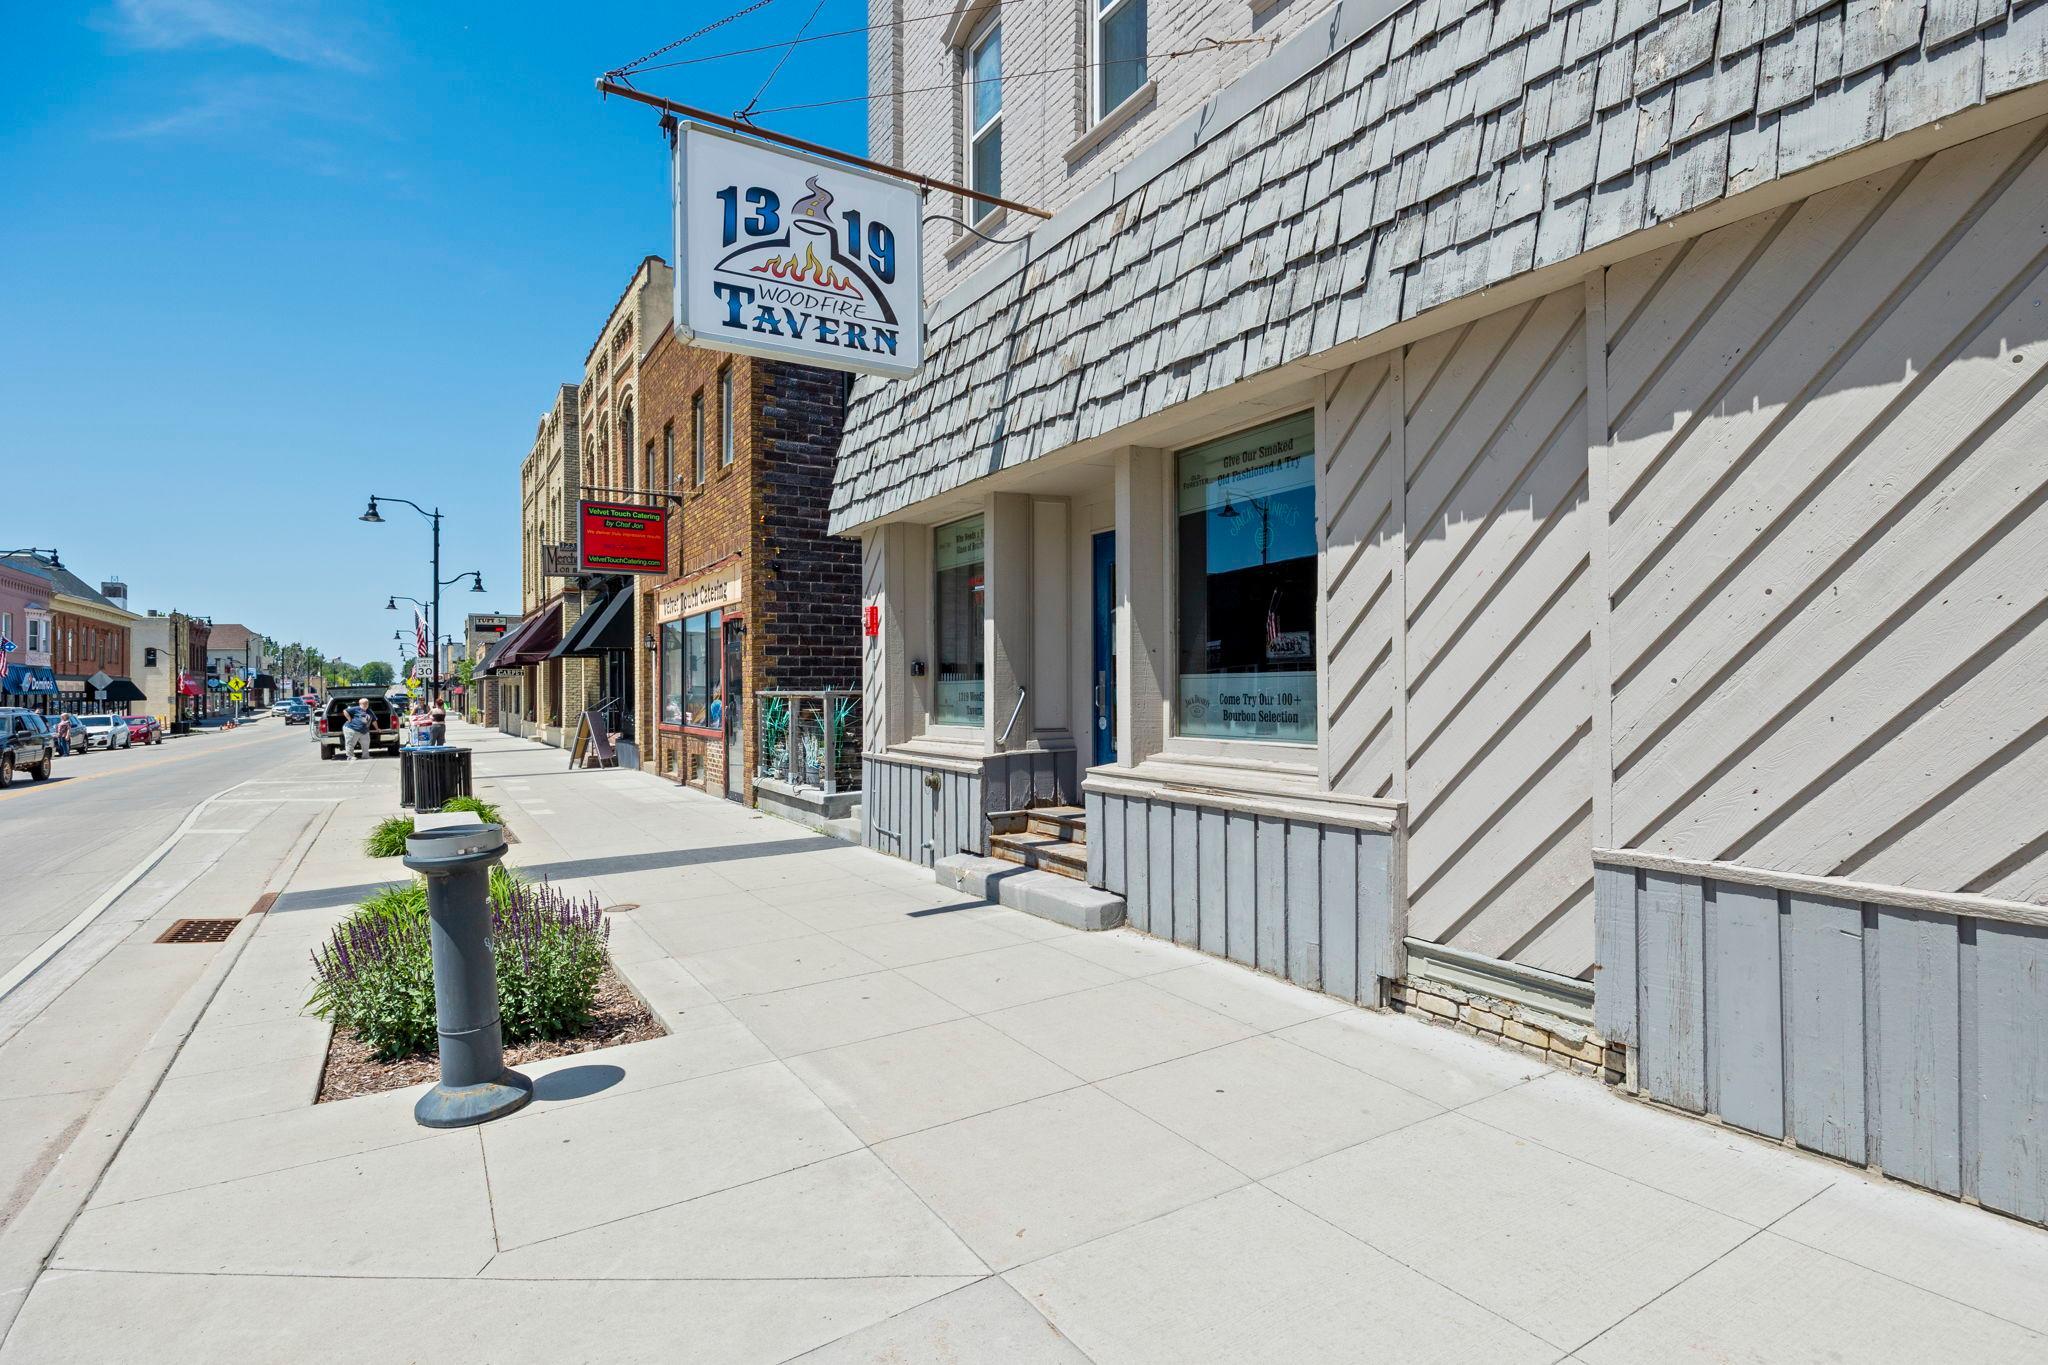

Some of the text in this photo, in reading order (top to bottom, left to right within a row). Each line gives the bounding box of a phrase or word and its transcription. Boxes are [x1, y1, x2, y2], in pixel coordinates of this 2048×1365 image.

[716, 185, 895, 285] 13 19
[759, 283, 867, 320] WOODFIRE
[713, 281, 900, 357] TAVERN
[1223, 438, 1294, 469] Give Our Smoked
[1217, 455, 1301, 487] Old Fashioned A Try
[588, 507, 661, 522] Velvet Touch Catering
[605, 520, 615, 528] by
[588, 555, 661, 566] VelvetTouchCatering.com
[663, 594, 680, 616] Velvet
[680, 587, 699, 611] Touch
[700, 579, 728, 605] Catering
[418, 667, 433, 676] 30
[1219, 693, 1240, 706] Come
[1242, 693, 1257, 708] Try
[1259, 693, 1274, 706] Our
[1222, 709, 1299, 723] Bourbon Selection
